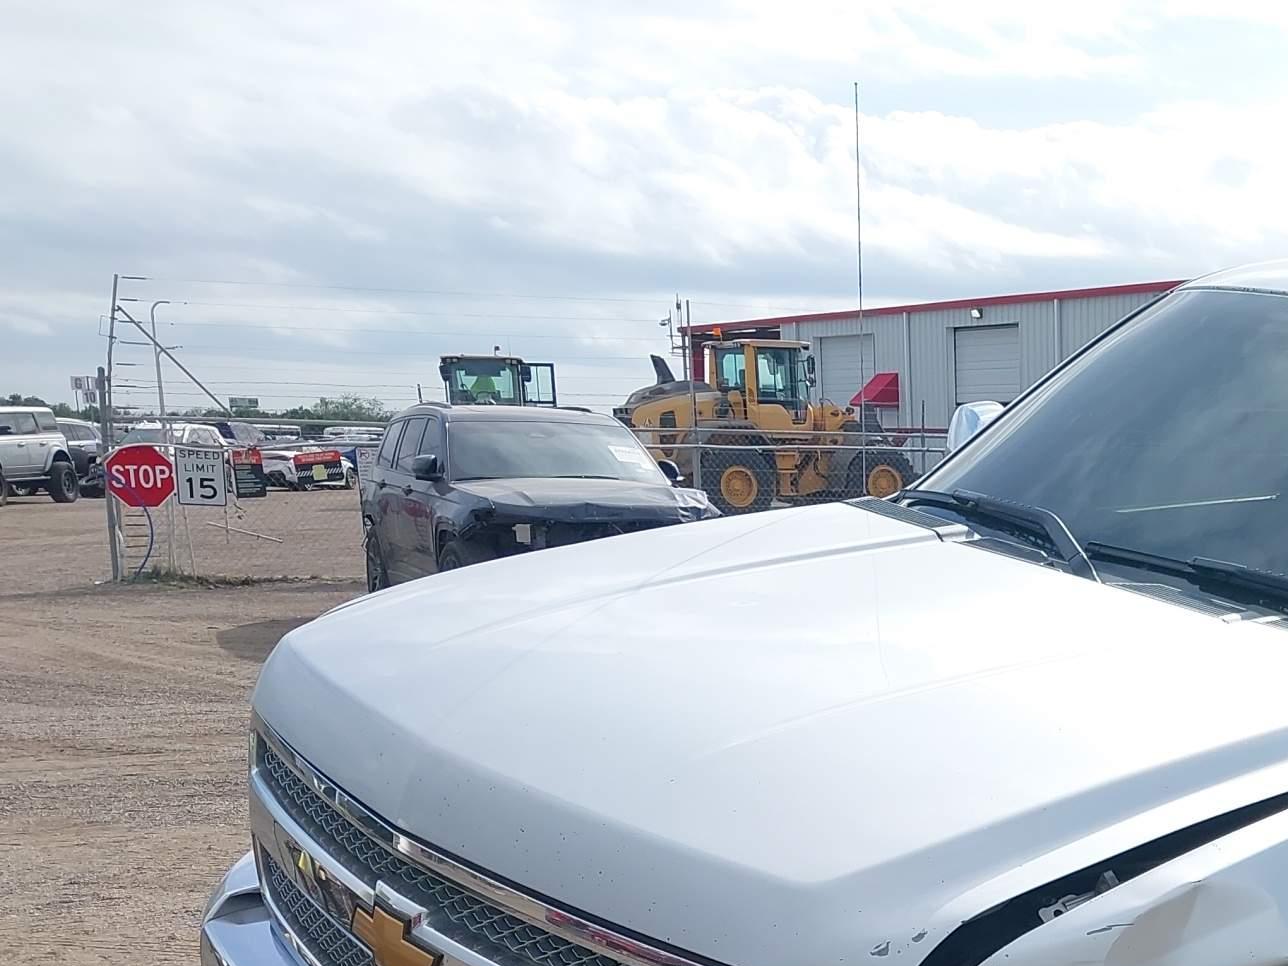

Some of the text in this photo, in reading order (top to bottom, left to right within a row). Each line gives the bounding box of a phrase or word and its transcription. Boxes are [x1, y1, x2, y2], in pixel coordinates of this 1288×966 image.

[179, 450, 221, 461] SPEED
[111, 464, 171, 489] STOP
[184, 463, 217, 473] LIMIT
[186, 477, 218, 500] 15
